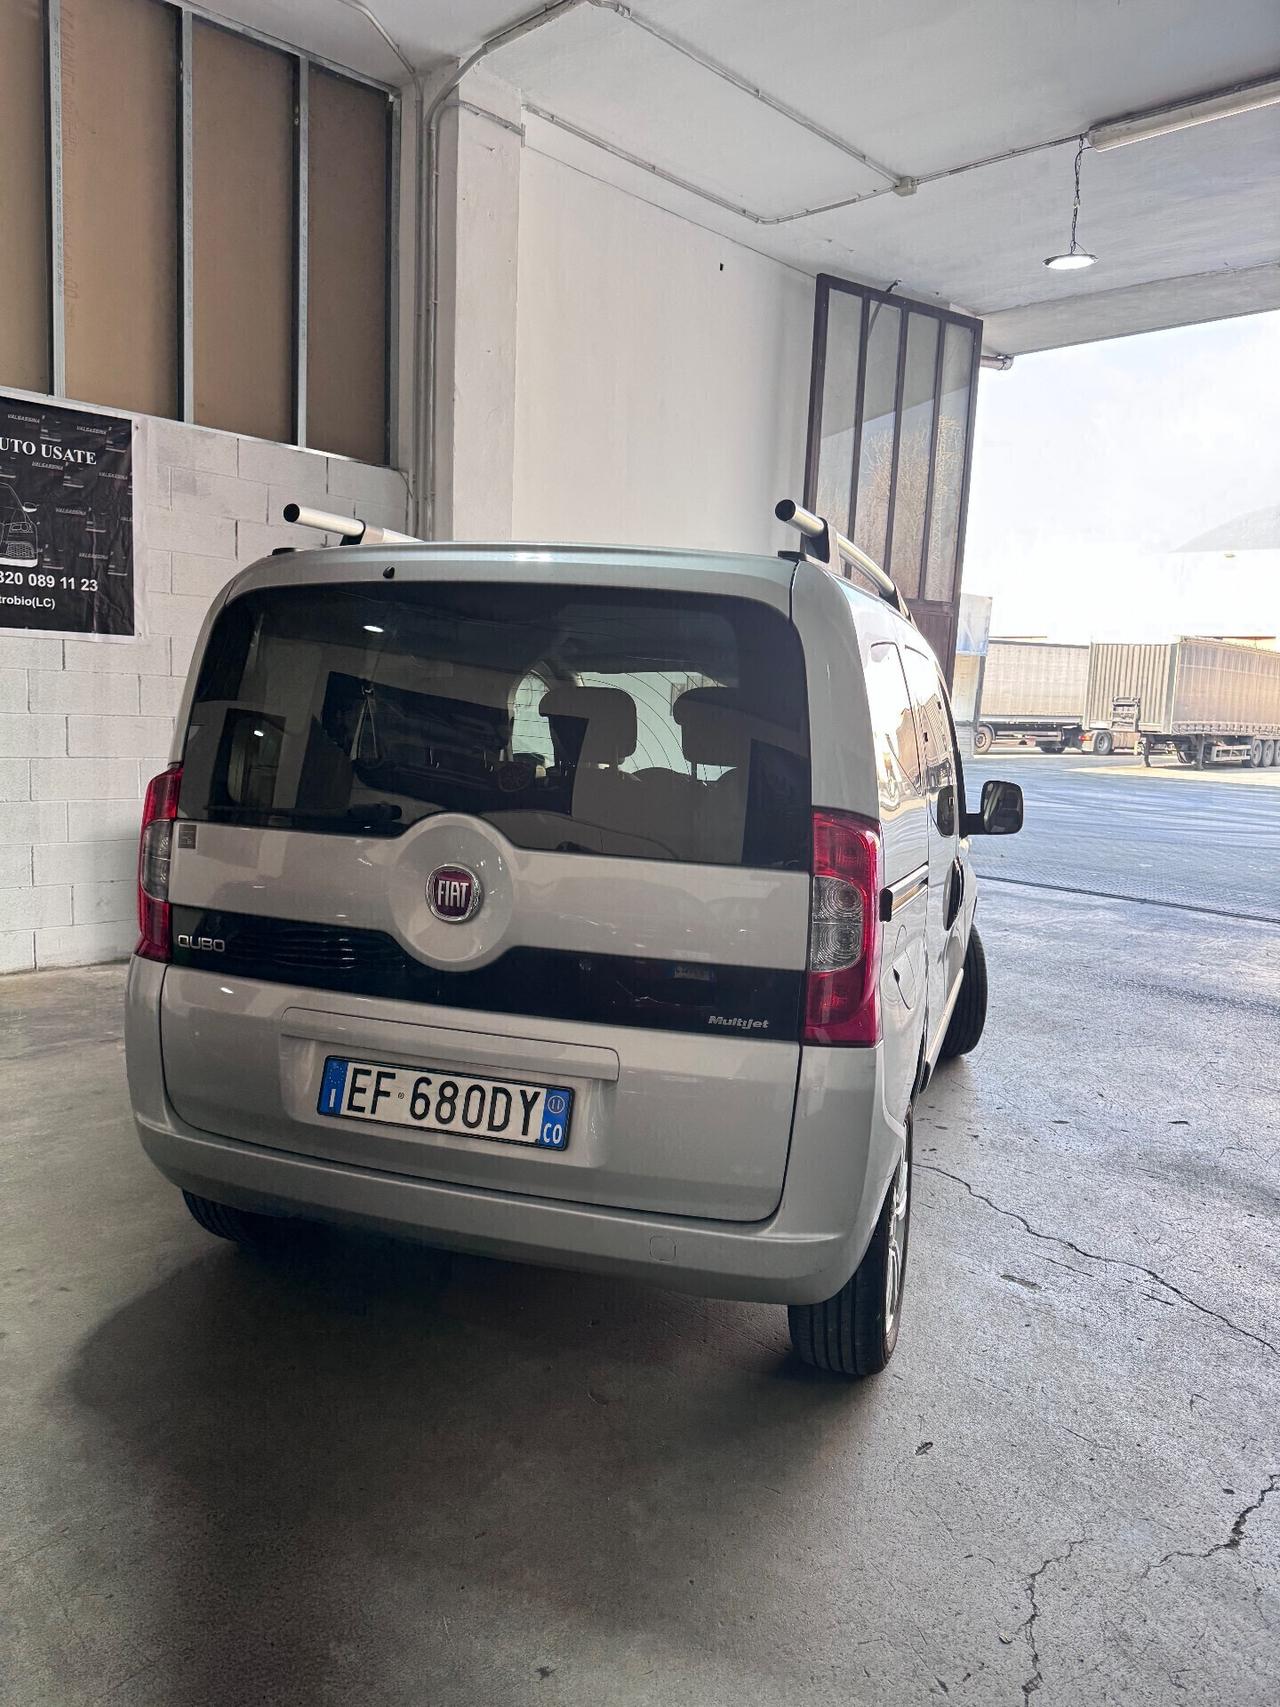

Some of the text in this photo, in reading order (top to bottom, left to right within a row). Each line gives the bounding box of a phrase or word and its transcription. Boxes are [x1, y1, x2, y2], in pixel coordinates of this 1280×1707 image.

[41, 444, 97, 465] USATE
[28, 573, 55, 588] 089
[60, 576, 75, 590] 11
[80, 579, 98, 592] 23
[437, 879, 470, 908] FIAT
[178, 934, 225, 952] QUBO
[543, 1122, 563, 1144] CO
